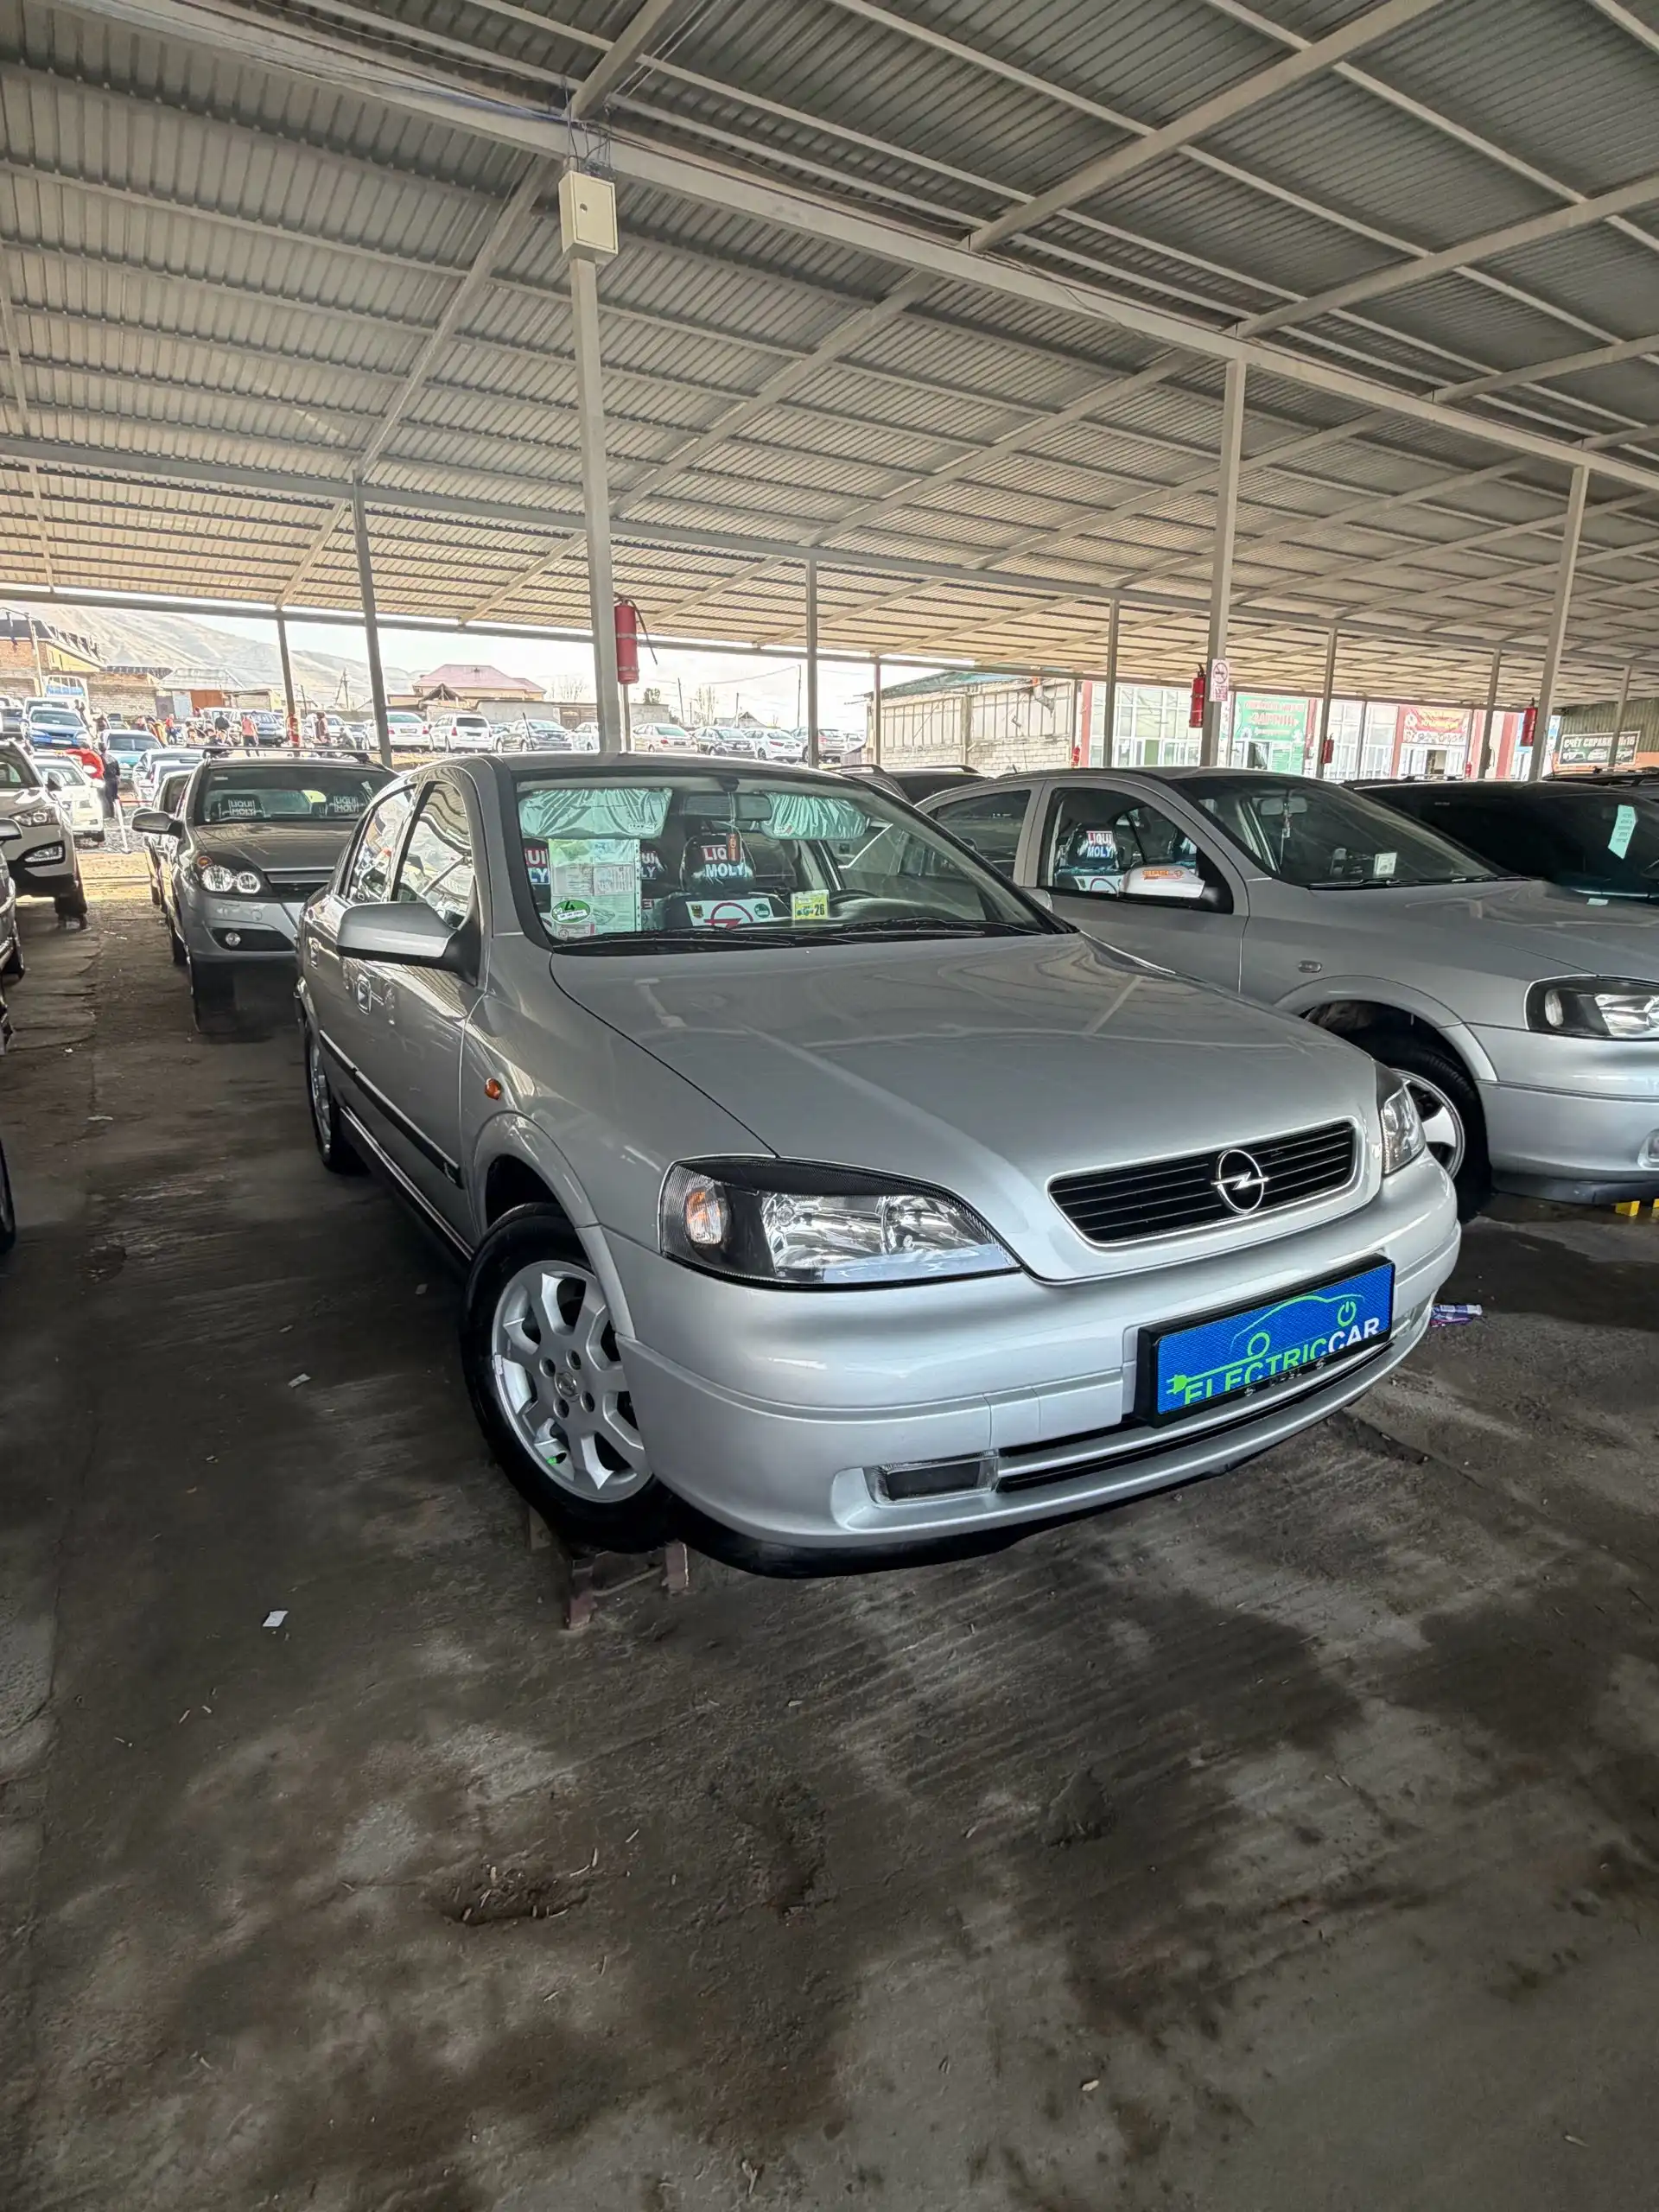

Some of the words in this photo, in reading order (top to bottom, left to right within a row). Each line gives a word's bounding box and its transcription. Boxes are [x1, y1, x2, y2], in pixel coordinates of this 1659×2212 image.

[1087, 833, 1113, 845] LIQUI
[1087, 846, 1113, 858] MOLY
[704, 863, 746, 878] MOLY
[814, 903, 825, 917] 26
